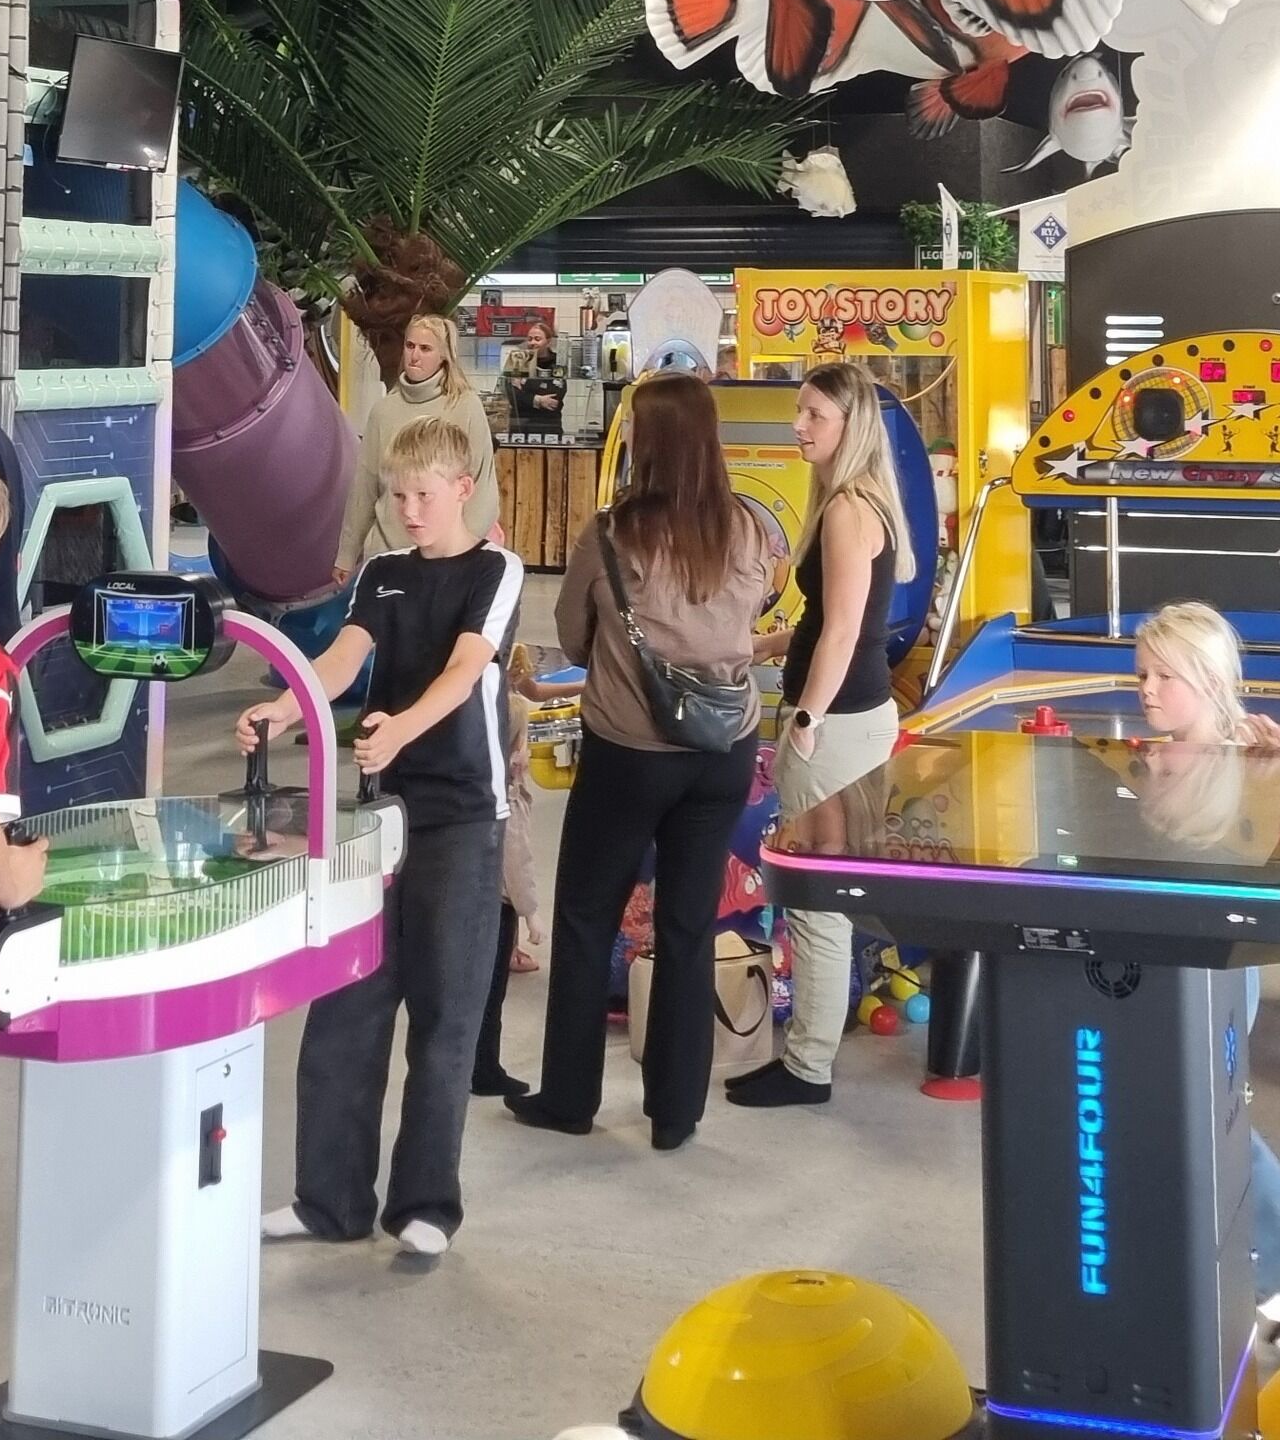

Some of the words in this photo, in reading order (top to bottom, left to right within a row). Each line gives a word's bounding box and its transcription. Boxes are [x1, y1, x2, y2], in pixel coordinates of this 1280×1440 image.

[1040, 225, 1060, 236] RYÅ
[1046, 237, 1055, 245] IS
[756, 289, 828, 325] TOY
[832, 288, 953, 326] STORY
[1109, 463, 1175, 481] New
[106, 582, 137, 591] LOCAL
[1076, 1027, 1108, 1295] FUN4FOUR
